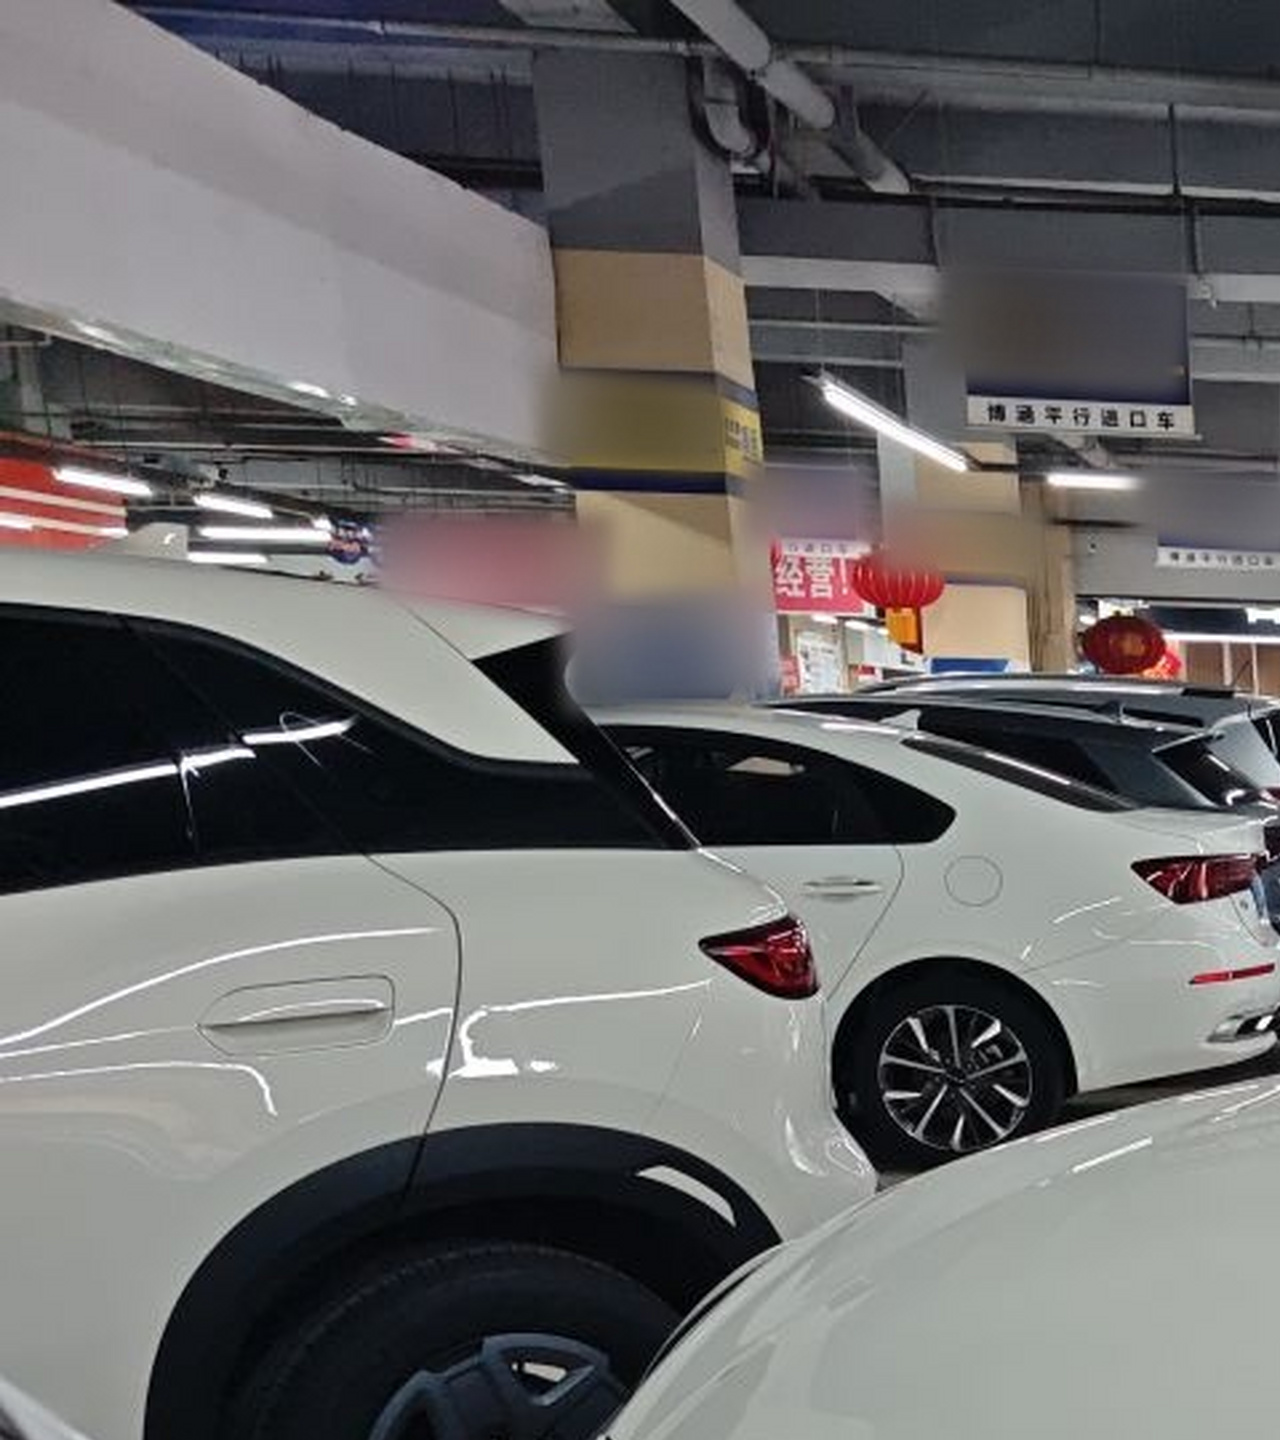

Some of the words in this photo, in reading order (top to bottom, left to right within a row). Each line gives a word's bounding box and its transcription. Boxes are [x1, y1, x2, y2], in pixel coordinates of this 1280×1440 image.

[988, 403, 1175, 430] 博涵平行进口车
